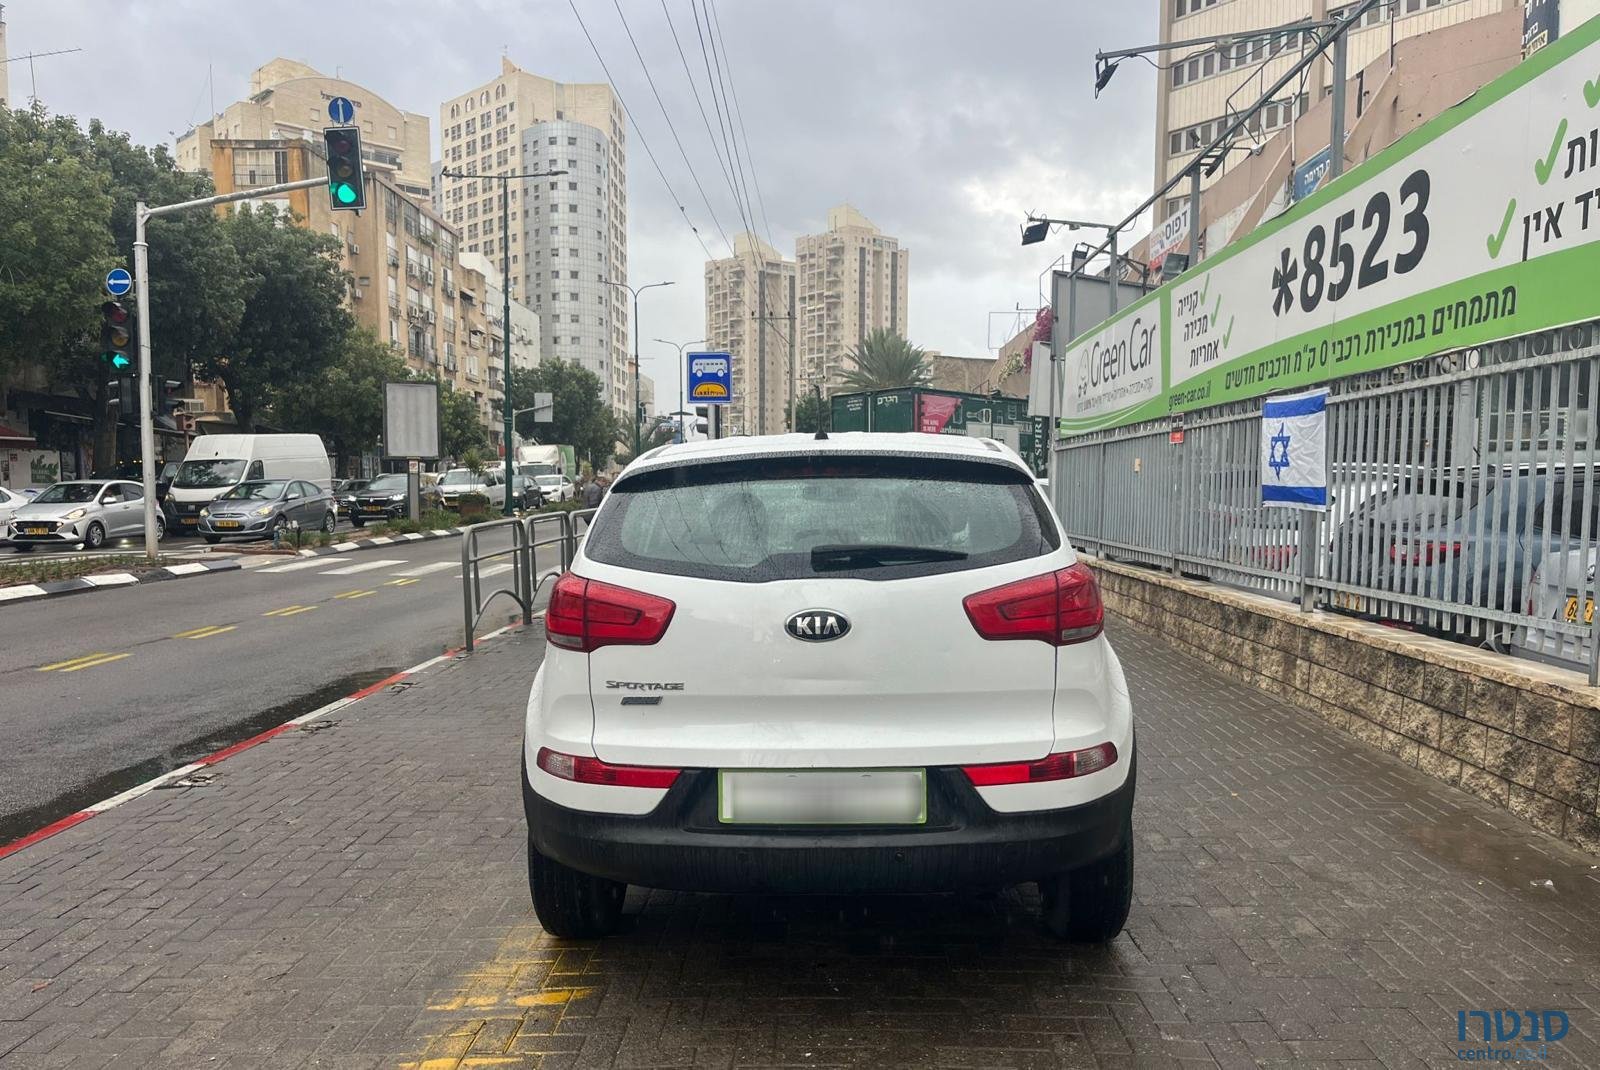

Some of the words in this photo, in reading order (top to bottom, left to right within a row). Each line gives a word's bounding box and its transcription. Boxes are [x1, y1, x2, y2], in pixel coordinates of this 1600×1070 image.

[1564, 128, 1598, 179] ות
[1165, 210, 1187, 240] דפוס
[1522, 201, 1565, 262] אין
[1178, 289, 1199, 317] קנייה
[1432, 285, 1517, 336] מתמחים
[1183, 313, 1209, 342] מכירה
[1364, 312, 1426, 354] במכירת
[1091, 339, 1126, 387] Green
[1130, 317, 1156, 371] Car
[1190, 338, 1220, 369] אחריות
[1319, 339, 1329, 367] 0
[1335, 337, 1361, 363] רכבי
[1225, 366, 1255, 390] חדשים
[1258, 353, 1291, 382] ורכבים
[796, 616, 839, 635] KIA
[605, 680, 684, 691] SPORTAGE
